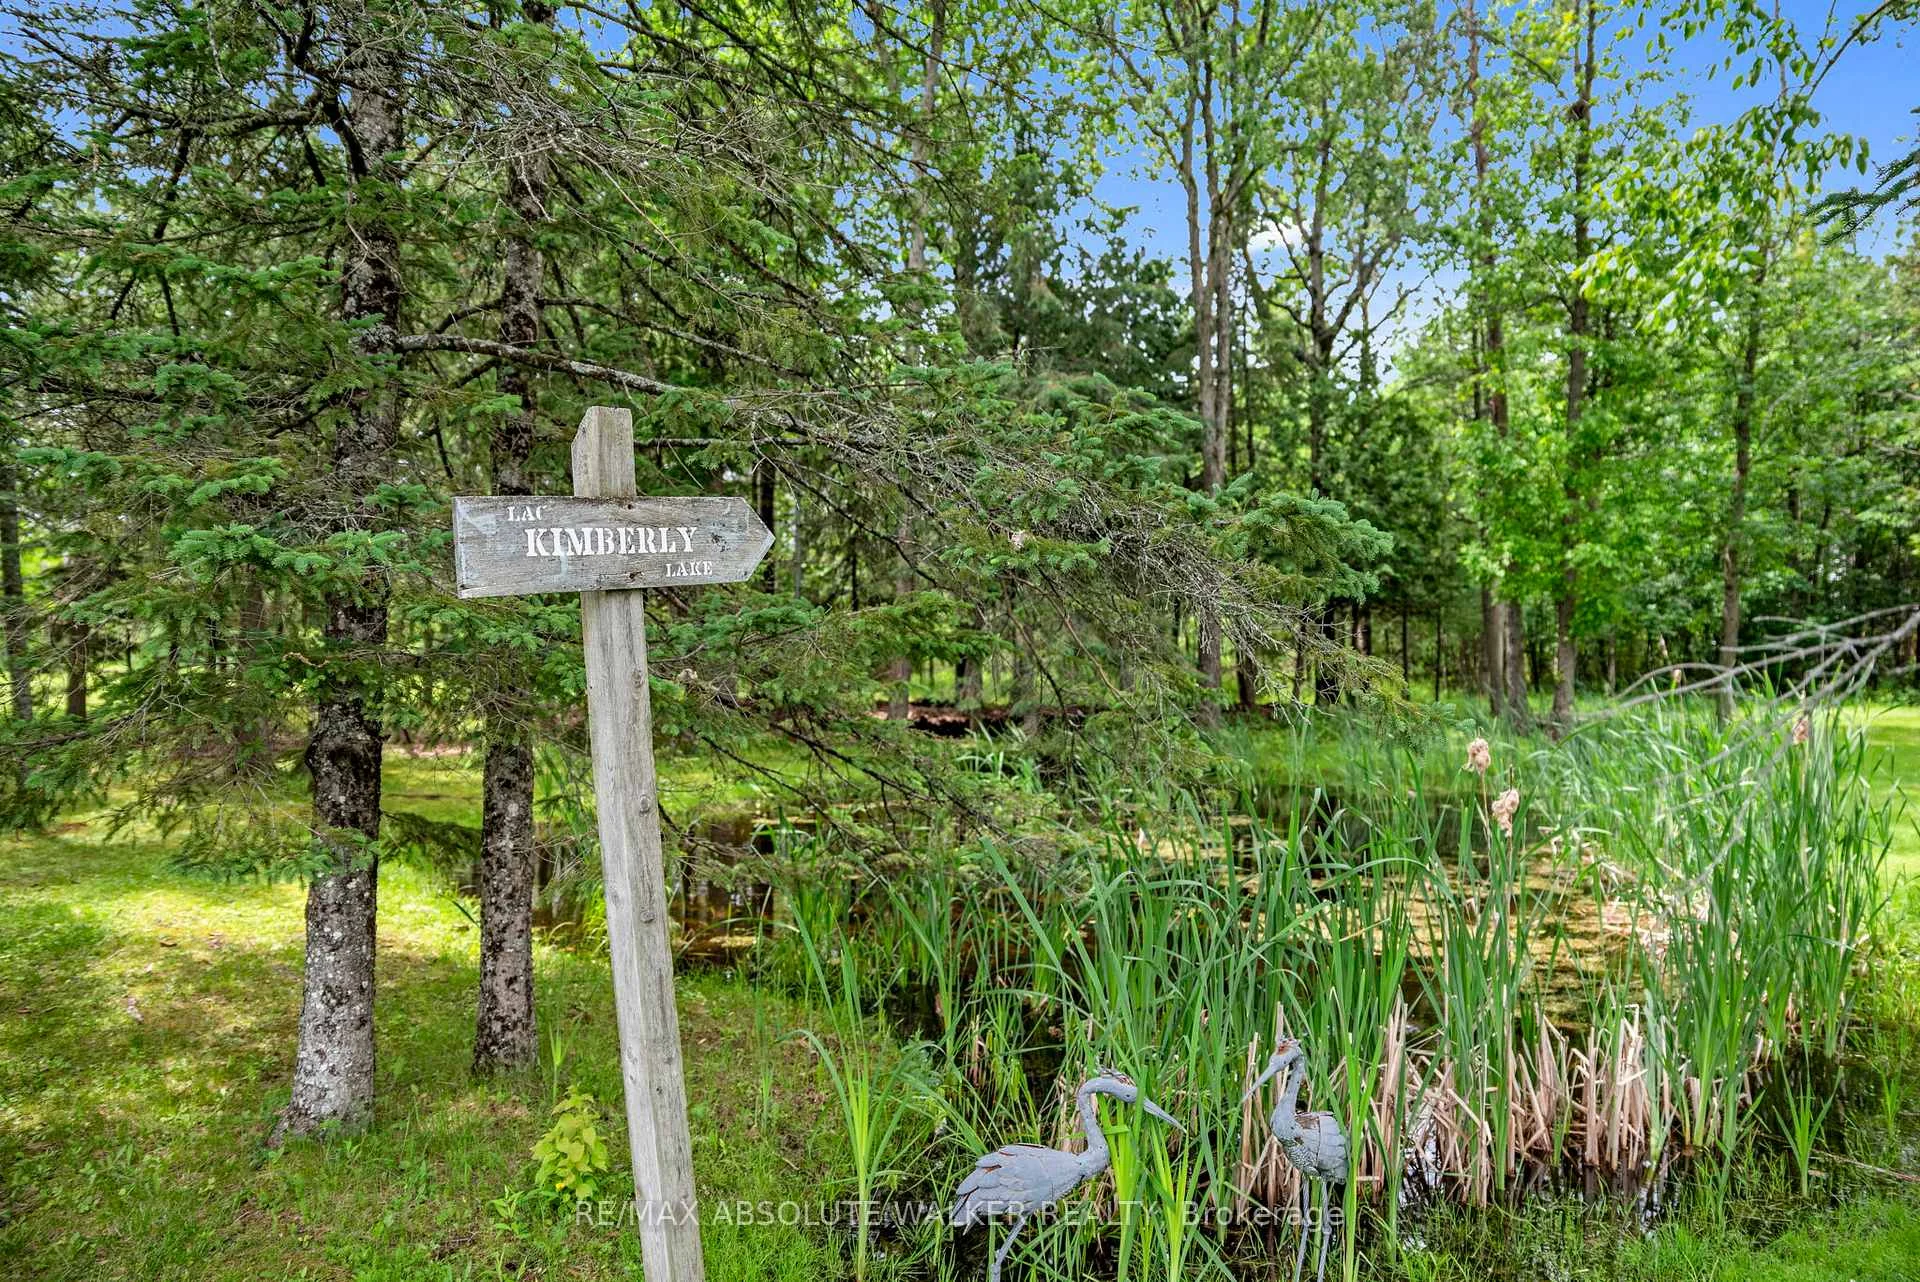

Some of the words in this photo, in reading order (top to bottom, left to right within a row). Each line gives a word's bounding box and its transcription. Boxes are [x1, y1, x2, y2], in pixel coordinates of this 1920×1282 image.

[506, 505, 546, 522] LAC
[524, 526, 698, 557] KIMBERLY
[665, 561, 714, 578] LAKE
